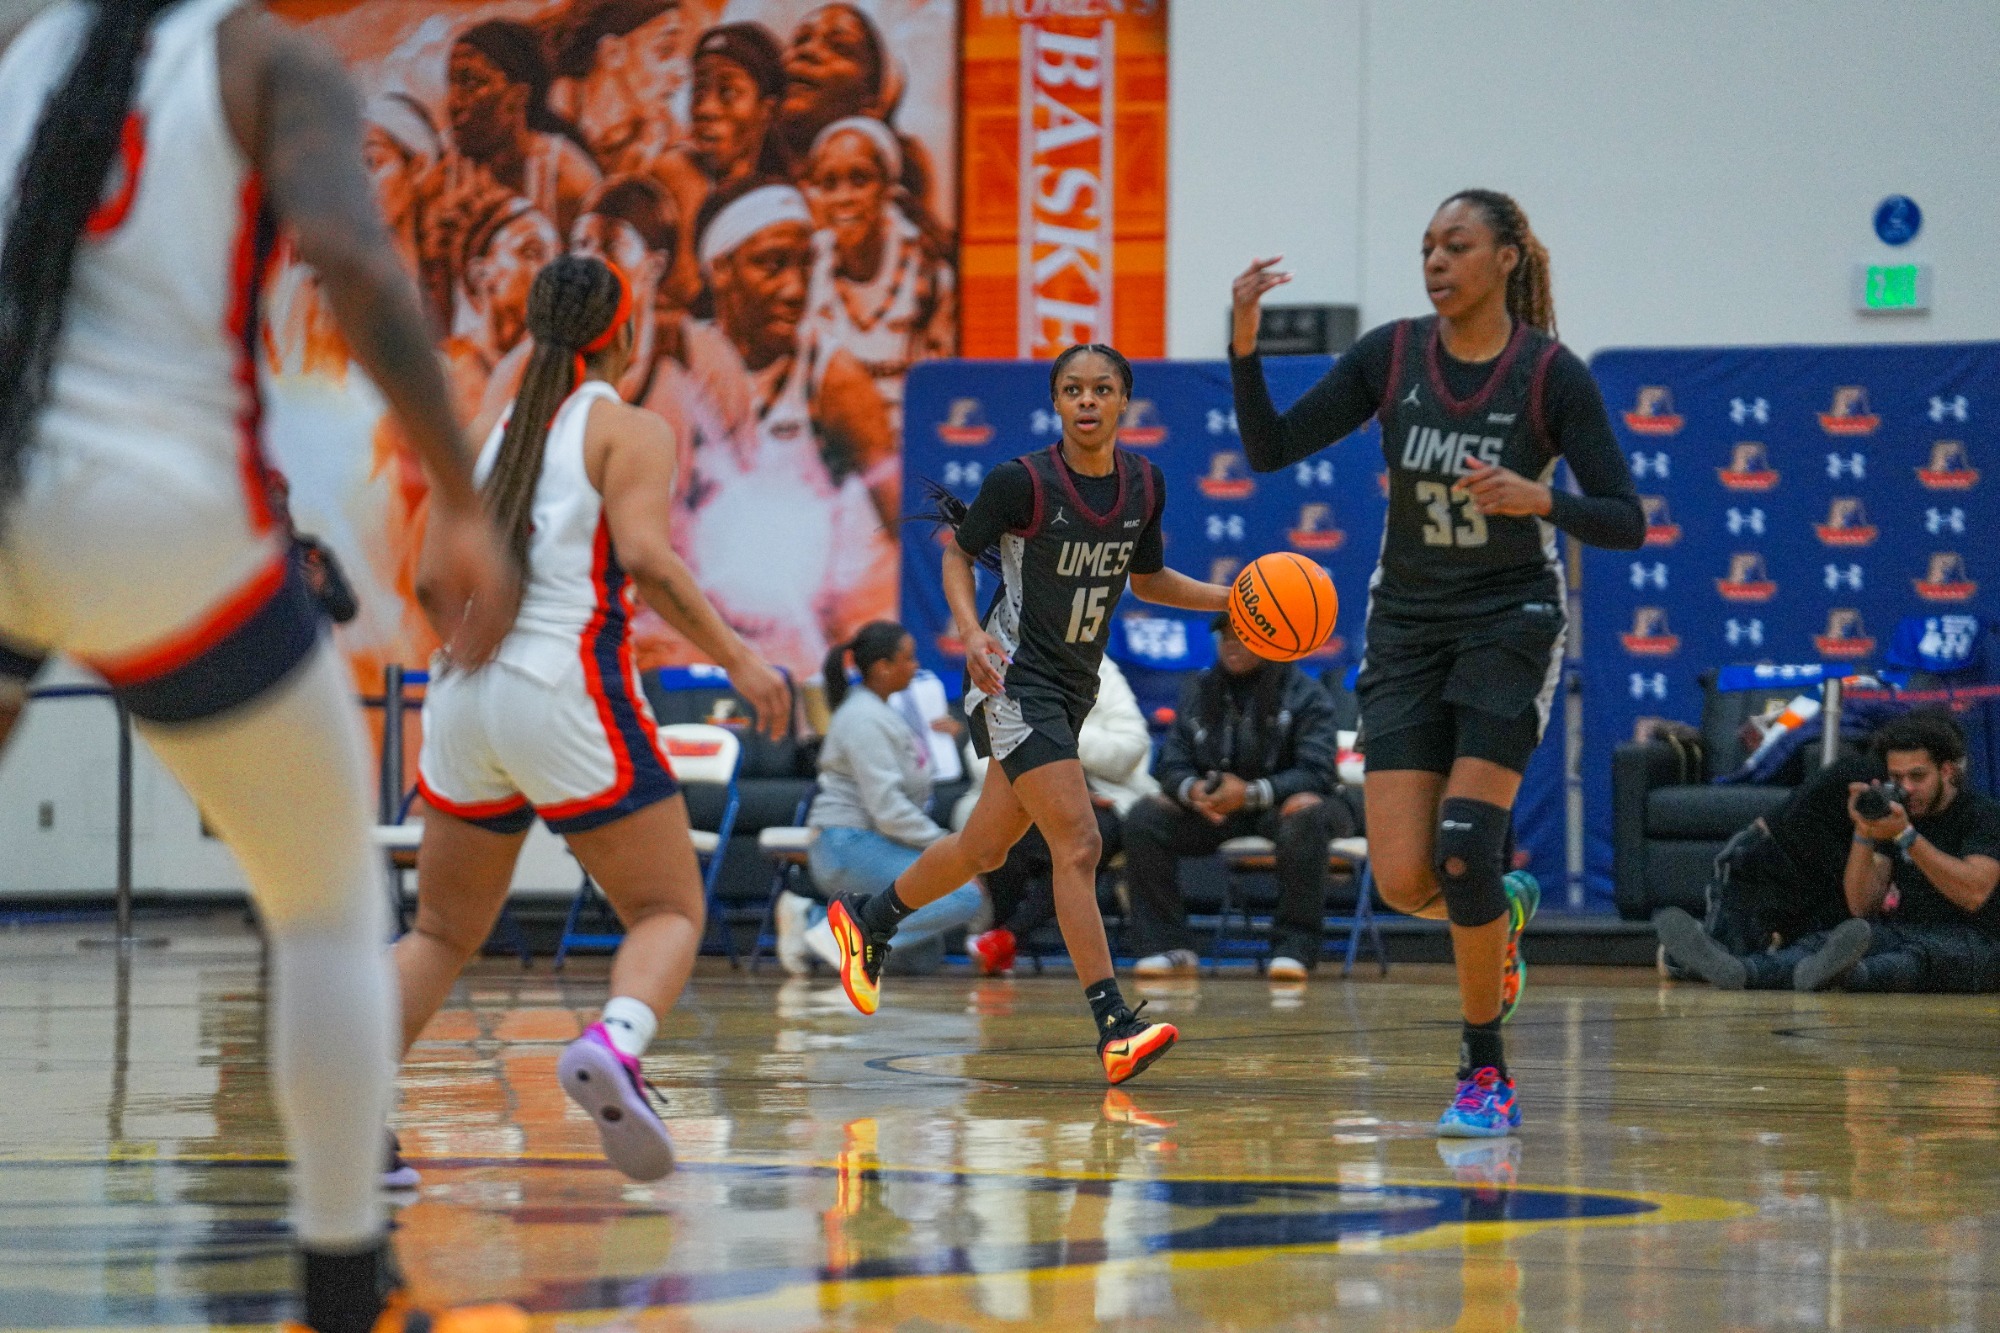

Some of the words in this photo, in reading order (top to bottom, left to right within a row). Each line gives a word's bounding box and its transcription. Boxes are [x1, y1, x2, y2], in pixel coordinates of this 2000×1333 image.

[1402, 425, 1504, 475] UMES
[1416, 480, 1488, 547] 33
[1056, 541, 1134, 577] UMES
[1065, 586, 1109, 643] 15
[1238, 570, 1277, 638] Wilson
